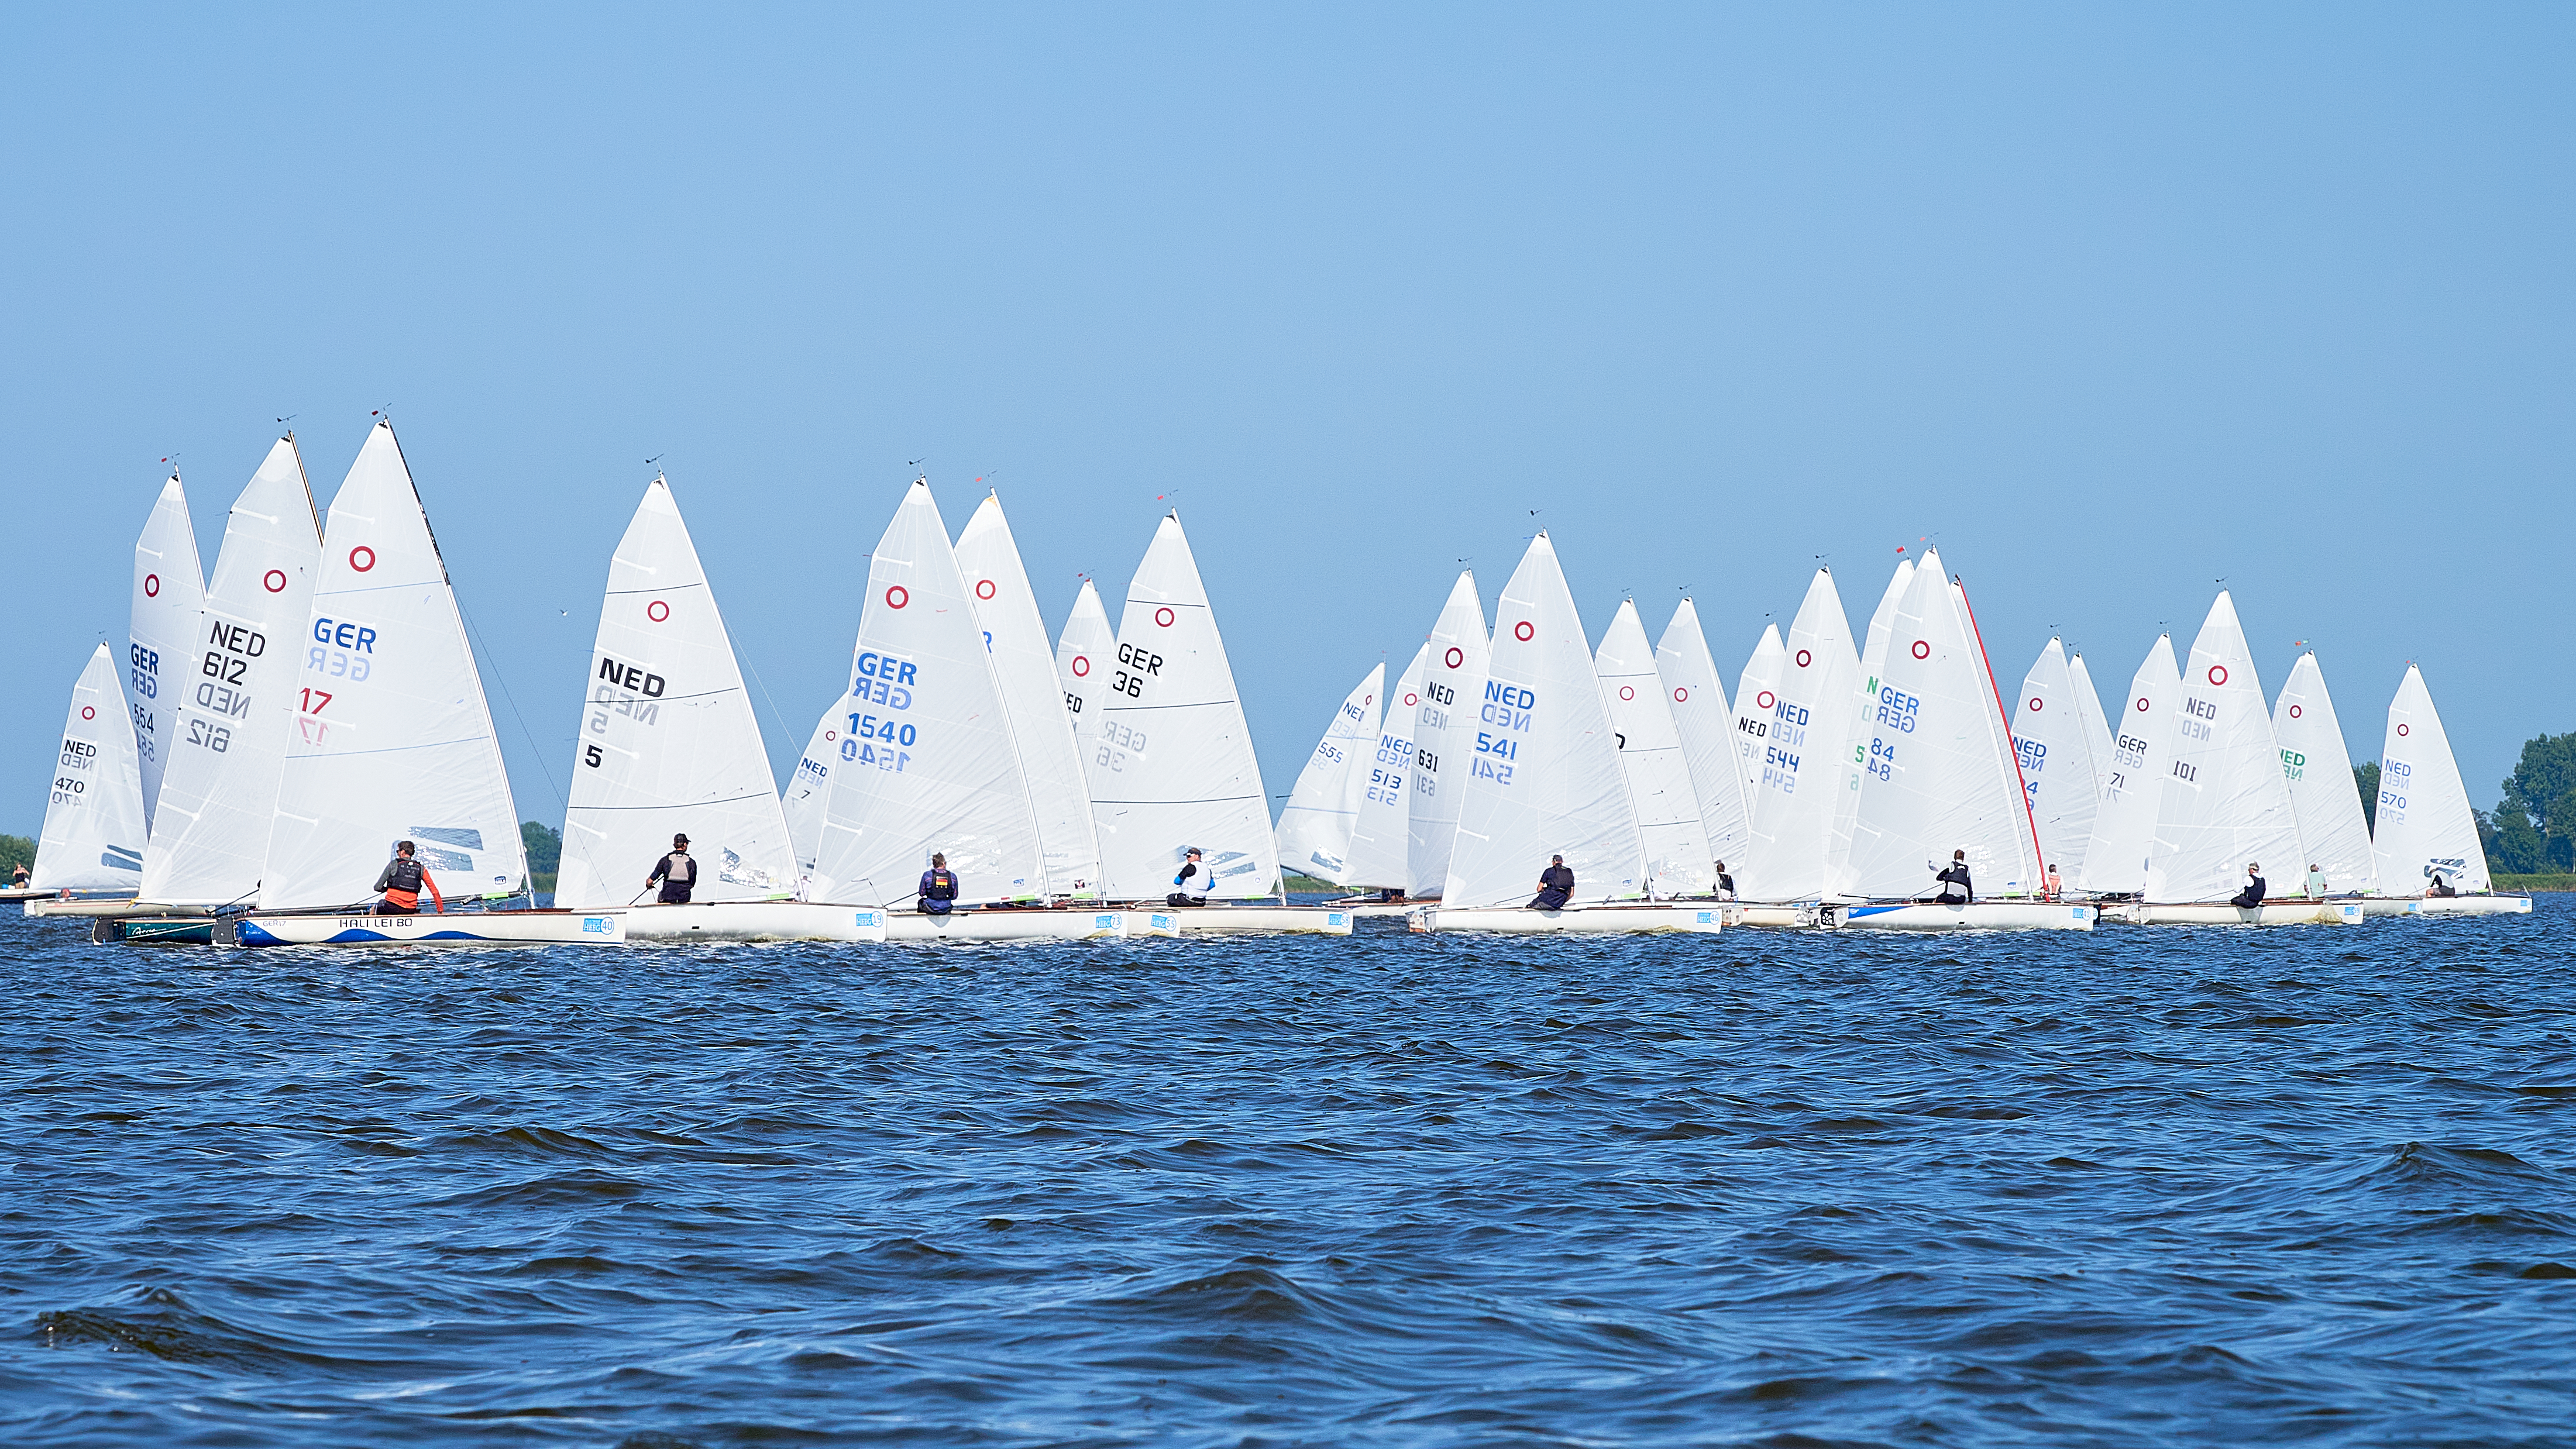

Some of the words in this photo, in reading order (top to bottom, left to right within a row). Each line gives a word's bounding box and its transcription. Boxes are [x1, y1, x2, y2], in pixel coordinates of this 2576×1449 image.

[209, 621, 266, 658] NED
[314, 618, 376, 654] GER
[131, 643, 159, 675] GER
[202, 651, 247, 686] 612
[858, 652, 917, 686] GER
[1118, 643, 1163, 676] GER
[599, 658, 665, 698] NED
[1113, 670, 1143, 698] 36
[299, 687, 332, 715] 17
[1064, 691, 1082, 713] ED
[1427, 681, 1454, 705] NED
[1484, 680, 1535, 710] NED
[1881, 687, 1919, 716] GER
[134, 703, 154, 734] 554
[1776, 700, 1809, 726] NED
[2186, 697, 2216, 720] NED
[848, 713, 916, 746] 1540
[1738, 717, 1767, 737] NED
[64, 739, 97, 757] NED
[585, 744, 603, 768] 5
[1319, 742, 1343, 763] 555
[1381, 735, 1413, 755] NED
[1476, 732, 1517, 760] 541
[1871, 738, 1894, 762] 84
[2013, 736, 2047, 758] NED
[2118, 735, 2147, 755] GER
[801, 758, 827, 777] NED
[1419, 749, 1438, 772] 631
[1766, 746, 1800, 772] 544
[2385, 759, 2410, 776] NED
[1371, 769, 1401, 789] 513
[2110, 772, 2124, 788] 71
[2173, 760, 2196, 782] 101
[56, 777, 84, 793] 470
[801, 790, 811, 799] 7
[2381, 791, 2406, 808] 570
[340, 919, 369, 928] HALI
[374, 919, 392, 927] LEI
[397, 918, 412, 927] BO
[602, 921, 613, 930] 40
[873, 915, 882, 923] 19
[1112, 917, 1120, 925] 73
[1167, 920, 1175, 928] 55
